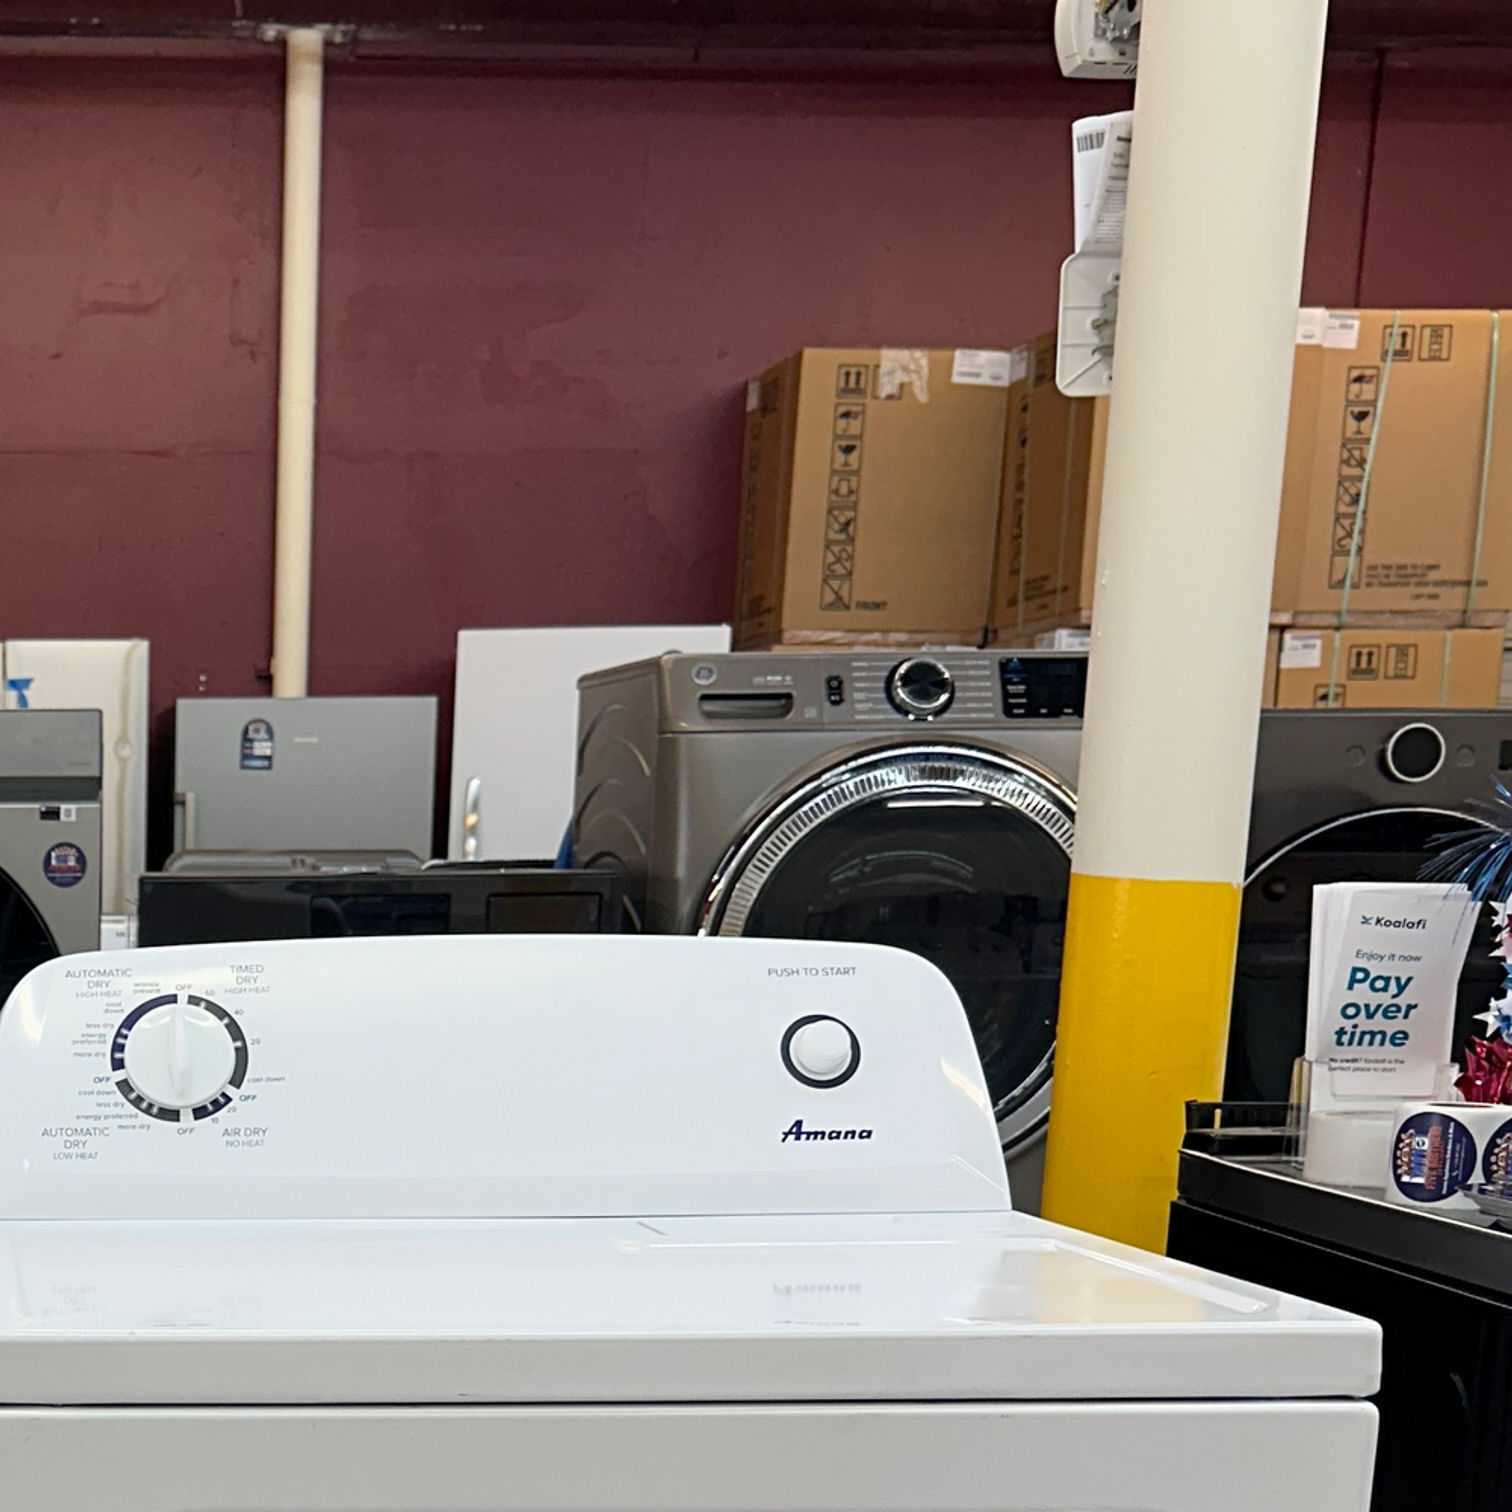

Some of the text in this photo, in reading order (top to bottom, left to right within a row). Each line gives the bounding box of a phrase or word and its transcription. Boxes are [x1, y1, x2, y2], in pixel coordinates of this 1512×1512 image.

[1374, 916, 1427, 930] Koalafi
[1355, 949, 1423, 962] Enjoy it now
[65, 968, 133, 979] AUTOMATIC
[230, 964, 264, 974] TIMED
[768, 966, 857, 978] PUSH TO START
[87, 980, 111, 990] DRY
[236, 975, 259, 986] DRY
[1346, 966, 1414, 999] Pay
[175, 983, 193, 992] OFF
[224, 986, 271, 995] HIGH HEAT
[100, 989, 123, 998] HEAT
[1340, 1002, 1419, 1020] over
[1334, 1024, 1410, 1047] time
[93, 1076, 111, 1084] OFF
[239, 1094, 257, 1102] OFF
[41, 1127, 110, 1138] AUTOMATIC
[177, 1127, 196, 1136] OFF
[222, 1126, 269, 1138] AIR DRY
[781, 1118, 874, 1143] Amana
[63, 1139, 88, 1150] DRY
[225, 1139, 265, 1148] NO HEAT
[53, 1152, 98, 1160] LOW HEAT
